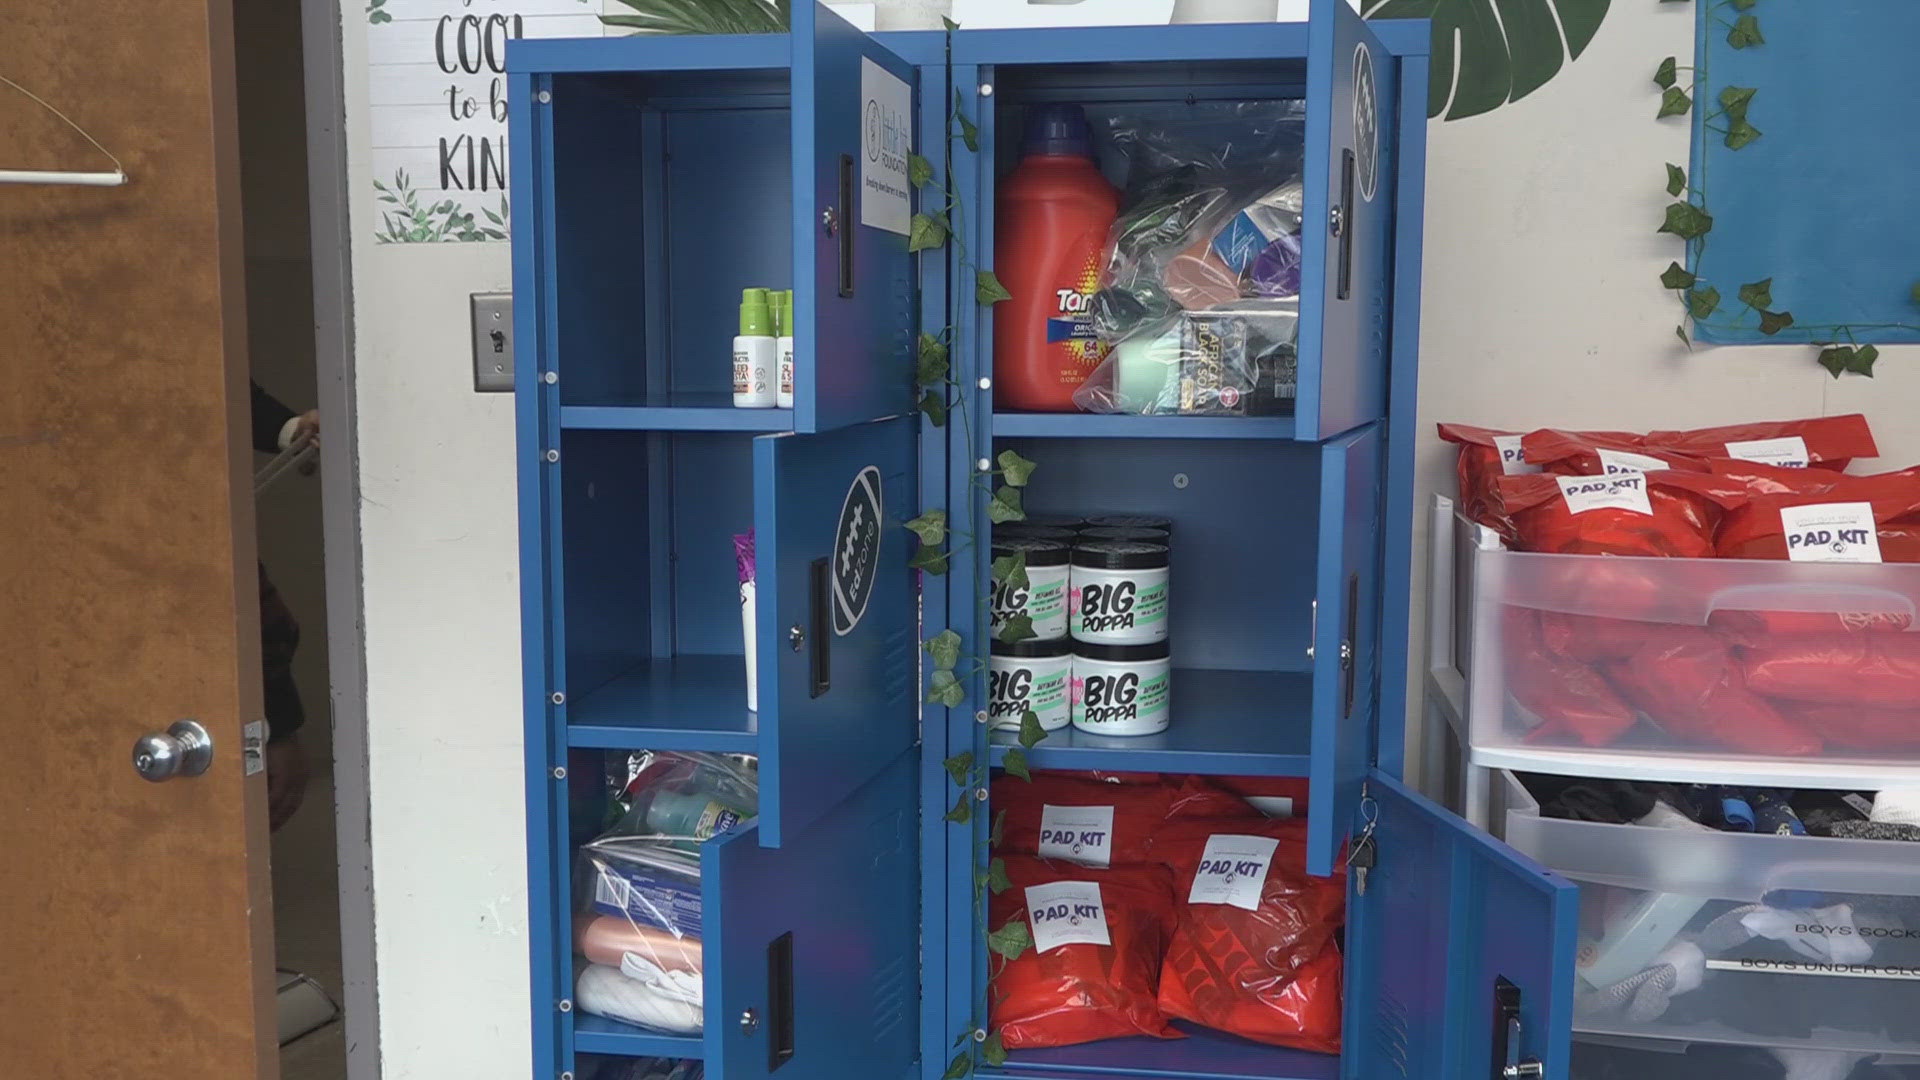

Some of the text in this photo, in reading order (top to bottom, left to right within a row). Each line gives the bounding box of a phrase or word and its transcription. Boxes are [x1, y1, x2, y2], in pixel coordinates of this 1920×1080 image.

[443, 78, 508, 123] to b
[439, 134, 505, 192] KIN
[1084, 341, 1098, 352] 64
[1503, 449, 1524, 462] PA
[1566, 483, 1606, 496] PAD
[1613, 478, 1641, 490] KIT
[1788, 529, 1869, 549] PAD KIT
[1081, 581, 1136, 616] BIG
[1082, 612, 1134, 633] POPPA
[1084, 672, 1139, 707] BIG
[990, 700, 1031, 717] OPPA
[1084, 703, 1137, 723] POPPA
[1041, 829, 1106, 846] PAD KIT
[1199, 860, 1263, 877] PAD KIT
[1033, 904, 1099, 924] PAD KIT
[1795, 924, 1920, 939] BOYS SOCK
[1741, 958, 1920, 977] BOYS UNDER CLO
